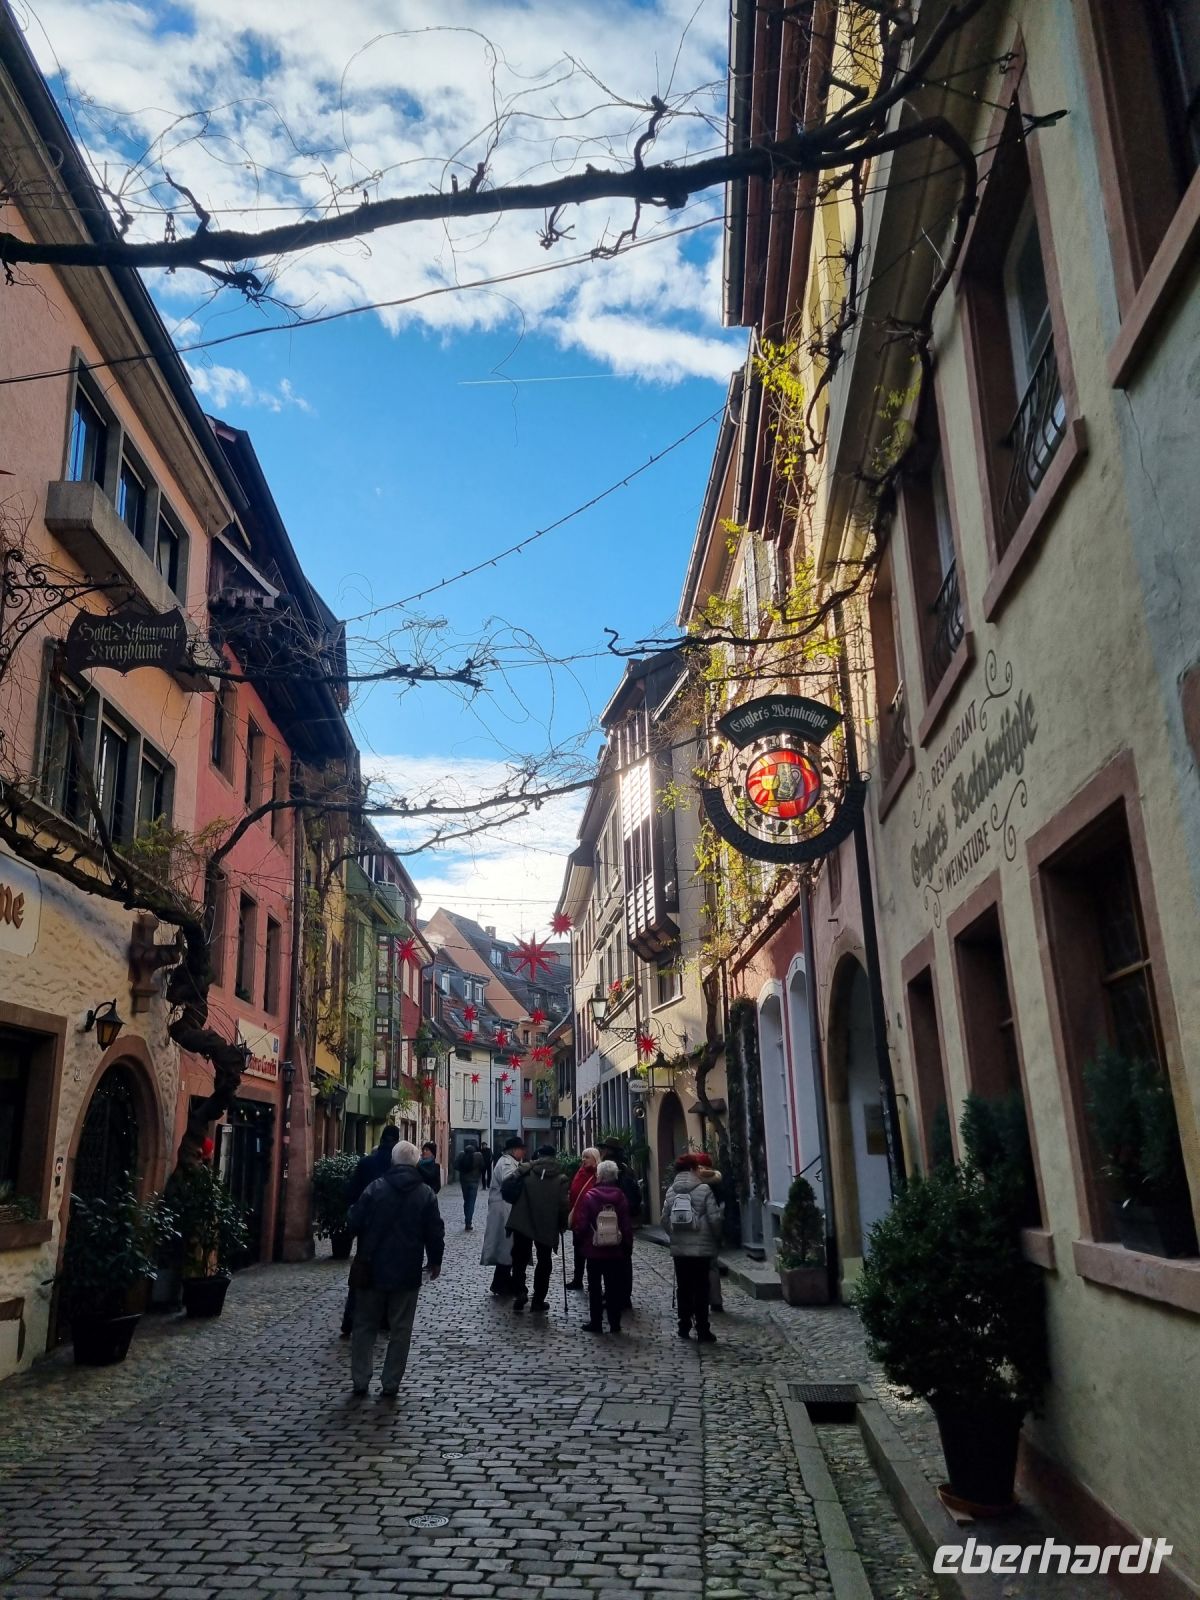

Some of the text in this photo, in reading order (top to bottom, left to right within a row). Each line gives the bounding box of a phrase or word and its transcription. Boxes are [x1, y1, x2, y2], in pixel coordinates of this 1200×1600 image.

[729, 704, 828, 733] Engler's Weinkrügle
[931, 699, 977, 791] RESTAURANT
[951, 688, 1038, 832] Weinkrügle
[944, 820, 991, 893] WEINSTUBE
